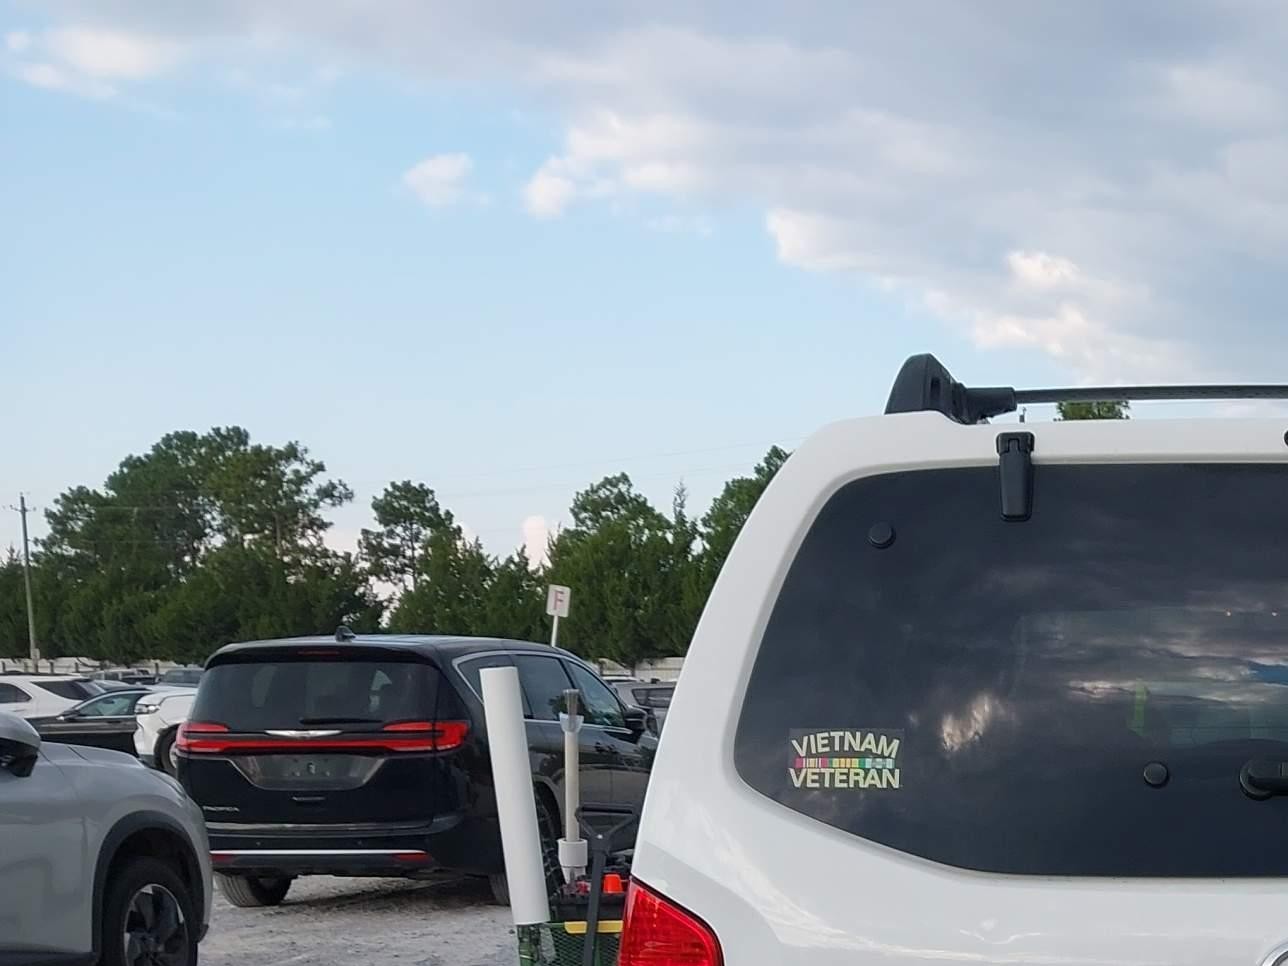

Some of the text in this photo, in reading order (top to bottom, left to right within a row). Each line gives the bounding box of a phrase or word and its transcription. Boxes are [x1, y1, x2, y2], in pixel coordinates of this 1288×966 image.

[553, 590, 564, 610] F
[791, 731, 900, 759] VIETNAM
[788, 767, 900, 788] VETERAN
